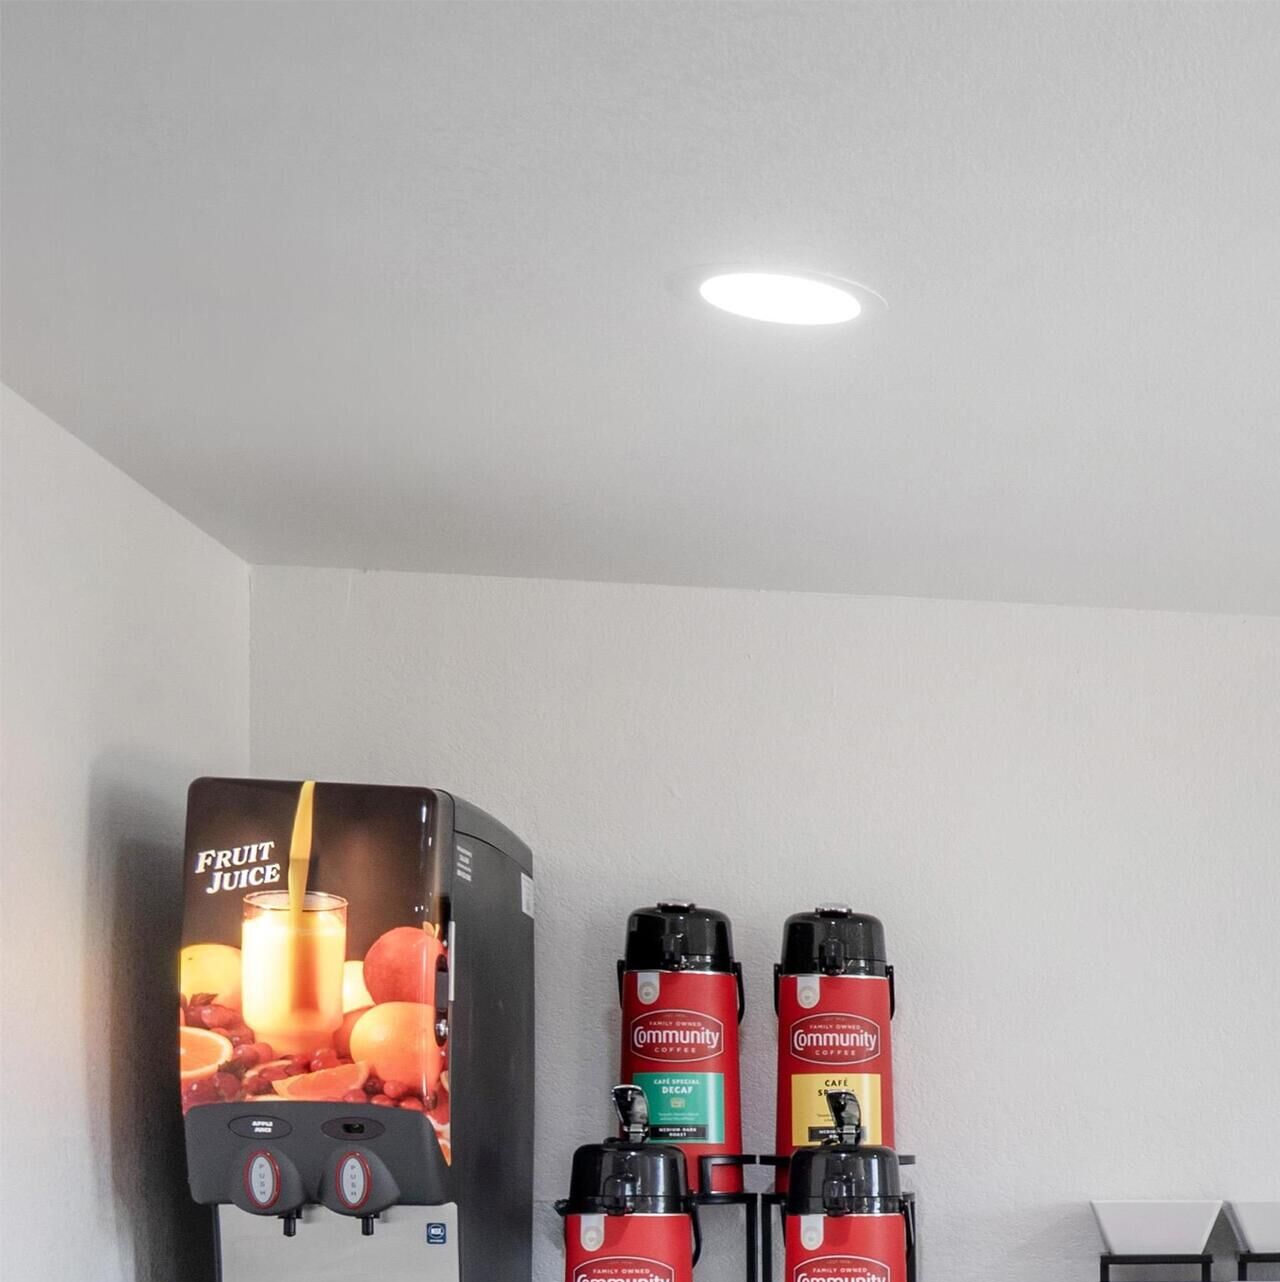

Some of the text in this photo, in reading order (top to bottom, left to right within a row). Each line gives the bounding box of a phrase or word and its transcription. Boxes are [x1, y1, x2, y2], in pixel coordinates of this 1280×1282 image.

[195, 841, 275, 874] FRUIT
[206, 863, 280, 894] JUICE
[633, 1026, 719, 1048] Community
[793, 1029, 877, 1051] Community
[662, 1086, 693, 1094] DECAF
[825, 1078, 848, 1087] CAFÉ
